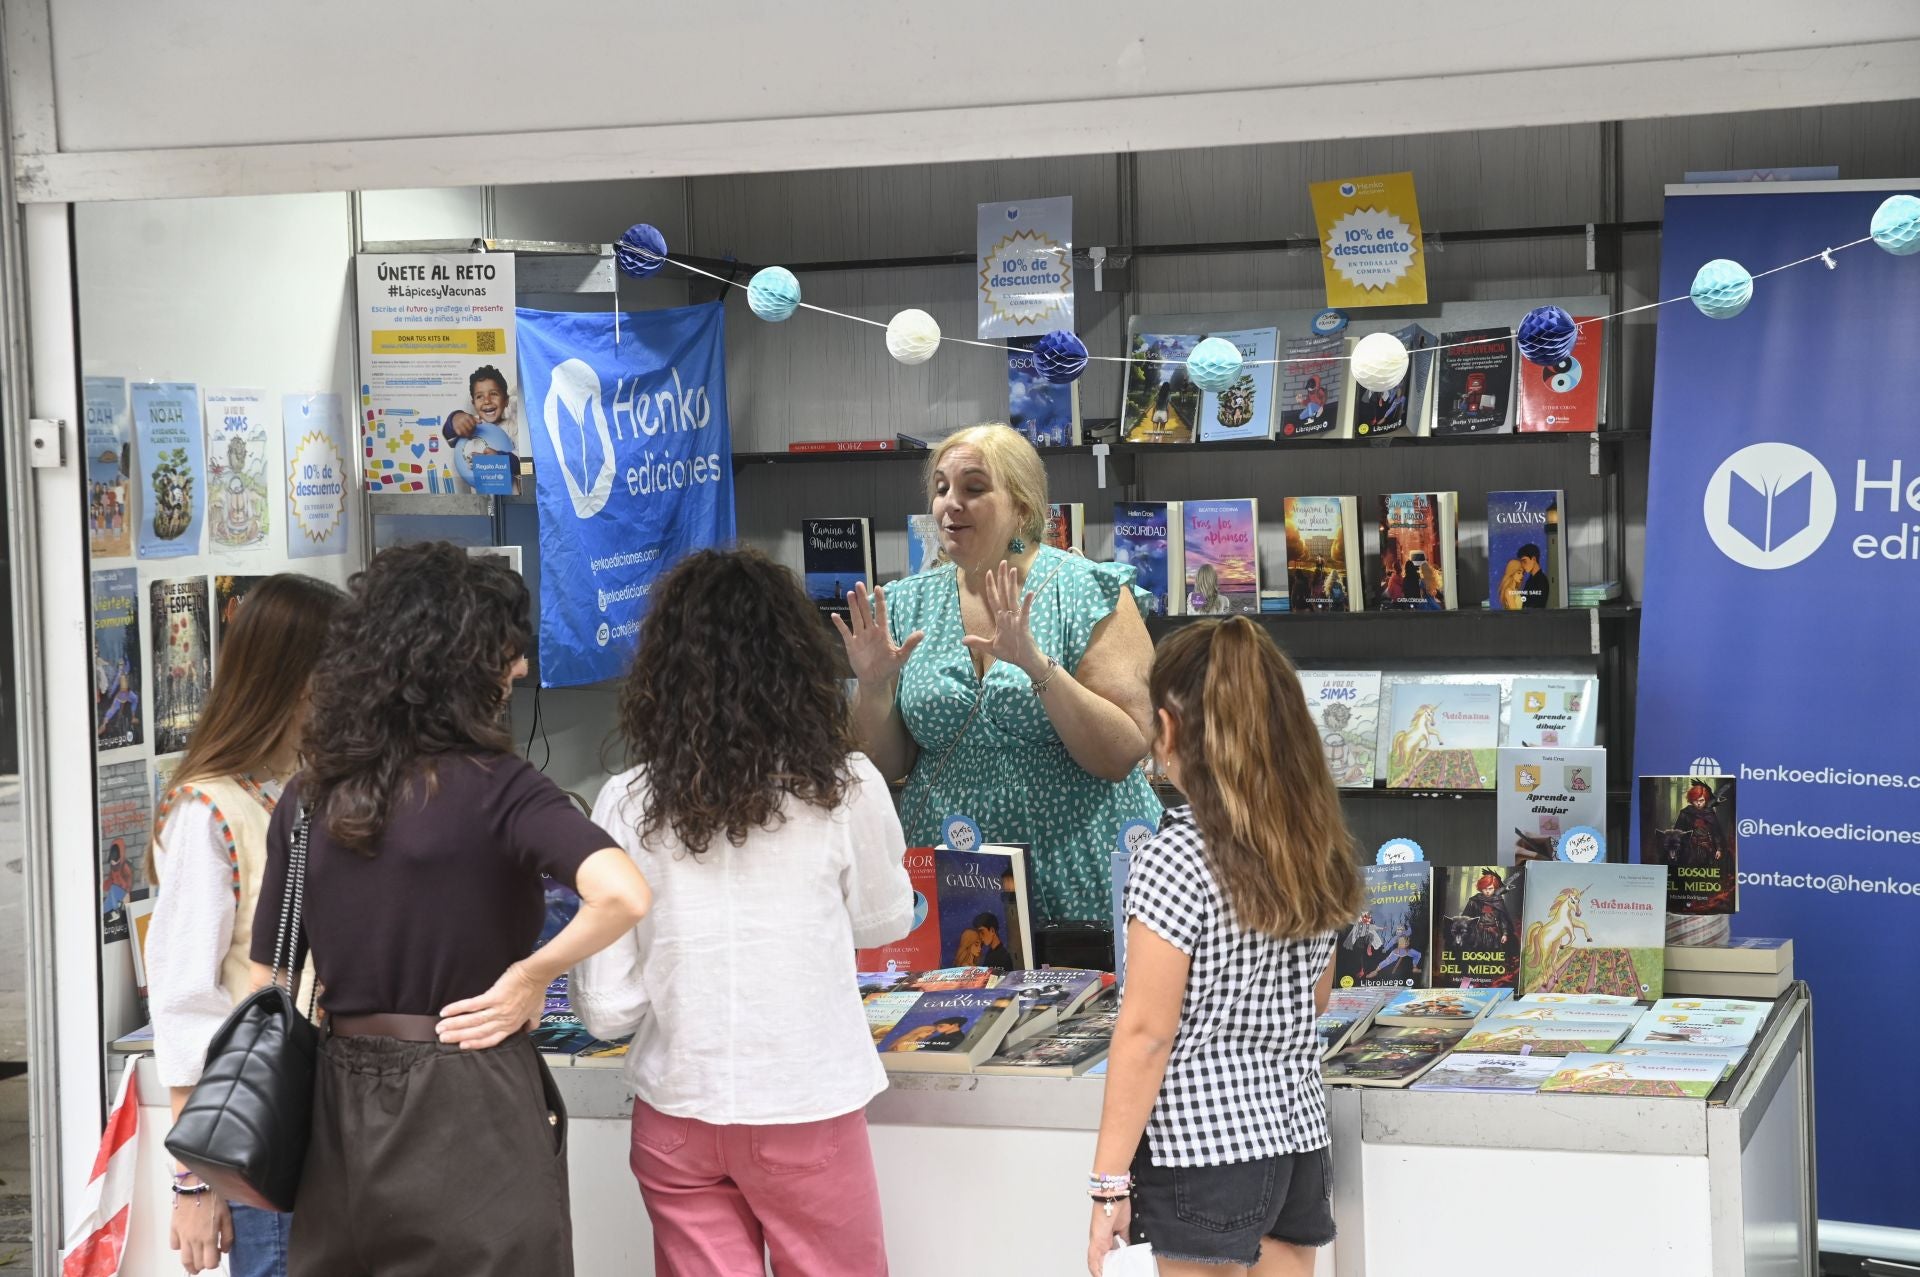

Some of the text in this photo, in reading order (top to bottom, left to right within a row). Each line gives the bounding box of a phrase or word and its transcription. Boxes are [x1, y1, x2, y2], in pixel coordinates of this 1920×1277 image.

[1345, 228, 1394, 242] 10% de
[1334, 241, 1409, 256] descuento
[377, 261, 496, 281] ÚNETE AL RETO
[1002, 259, 1048, 273] 10% de
[990, 273, 1060, 288] descuento
[388, 284, 487, 300] #LápicesyVacunas
[406, 305, 428, 313] futuro
[472, 304, 504, 314] presente
[612, 367, 711, 440] Henko
[87, 408, 113, 424] OAH
[149, 408, 184, 424] NOAH
[224, 416, 248, 432] SIMAS
[303, 464, 333, 480] 10% de
[626, 451, 722, 497] ediciones
[296, 481, 341, 496] descuento
[1514, 501, 1528, 512] 21
[1218, 514, 1231, 530] los
[1496, 512, 1546, 525] GALAXIAS
[810, 521, 857, 536] Camino al
[1115, 525, 1167, 537] OSCURIDAD
[809, 536, 858, 551] Multiverso
[1319, 688, 1357, 701] SIMAS
[1536, 723, 1566, 731] dibujar
[1740, 763, 1920, 789] henkoediciones.c
[1526, 793, 1568, 802] Aprende
[1531, 805, 1568, 815] dibujar
[1738, 818, 1920, 844] @henkoediciones
[902, 855, 933, 868] HOR
[965, 862, 980, 874] 21
[1677, 867, 1721, 878] BOSQUE
[946, 874, 1001, 890] GALAXIAS
[1667, 882, 1721, 892] EL MIEDO
[1441, 951, 1505, 962] EL BOSQUE
[1440, 964, 1505, 975] DEL MIEDO
[1360, 978, 1404, 987] Librojuego
[923, 999, 993, 1008] GALAXIAS
